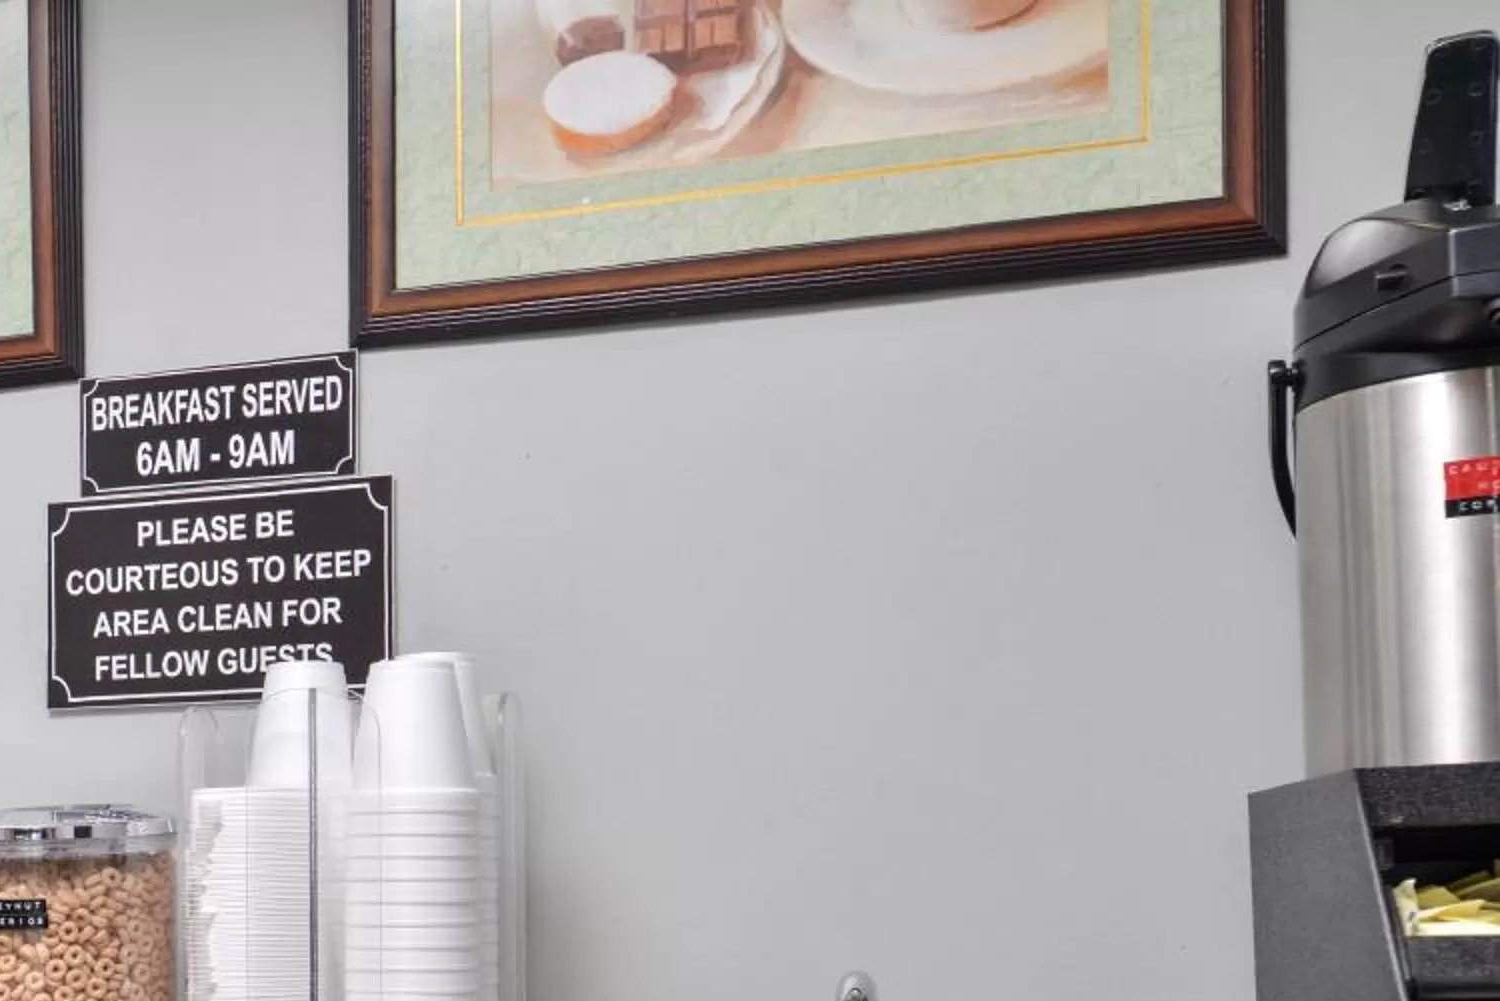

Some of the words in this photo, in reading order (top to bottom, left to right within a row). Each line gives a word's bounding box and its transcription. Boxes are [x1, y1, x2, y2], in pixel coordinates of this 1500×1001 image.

[91, 384, 237, 432] BREAKFAST
[241, 375, 343, 419] SERVED
[136, 437, 201, 477] 6AM
[209, 452, 221, 462] -
[228, 429, 295, 469] 9AM
[137, 513, 248, 548] PLEASE
[255, 510, 295, 539] BE
[65, 557, 239, 596] COURTEOUS
[246, 555, 286, 584] TO
[293, 549, 372, 581] KEEP
[92, 608, 171, 639] AREA
[177, 600, 273, 633] CLEAN
[281, 596, 343, 627] FOR
[95, 649, 211, 682] FELLOW
[217, 642, 333, 675] GUESTS
